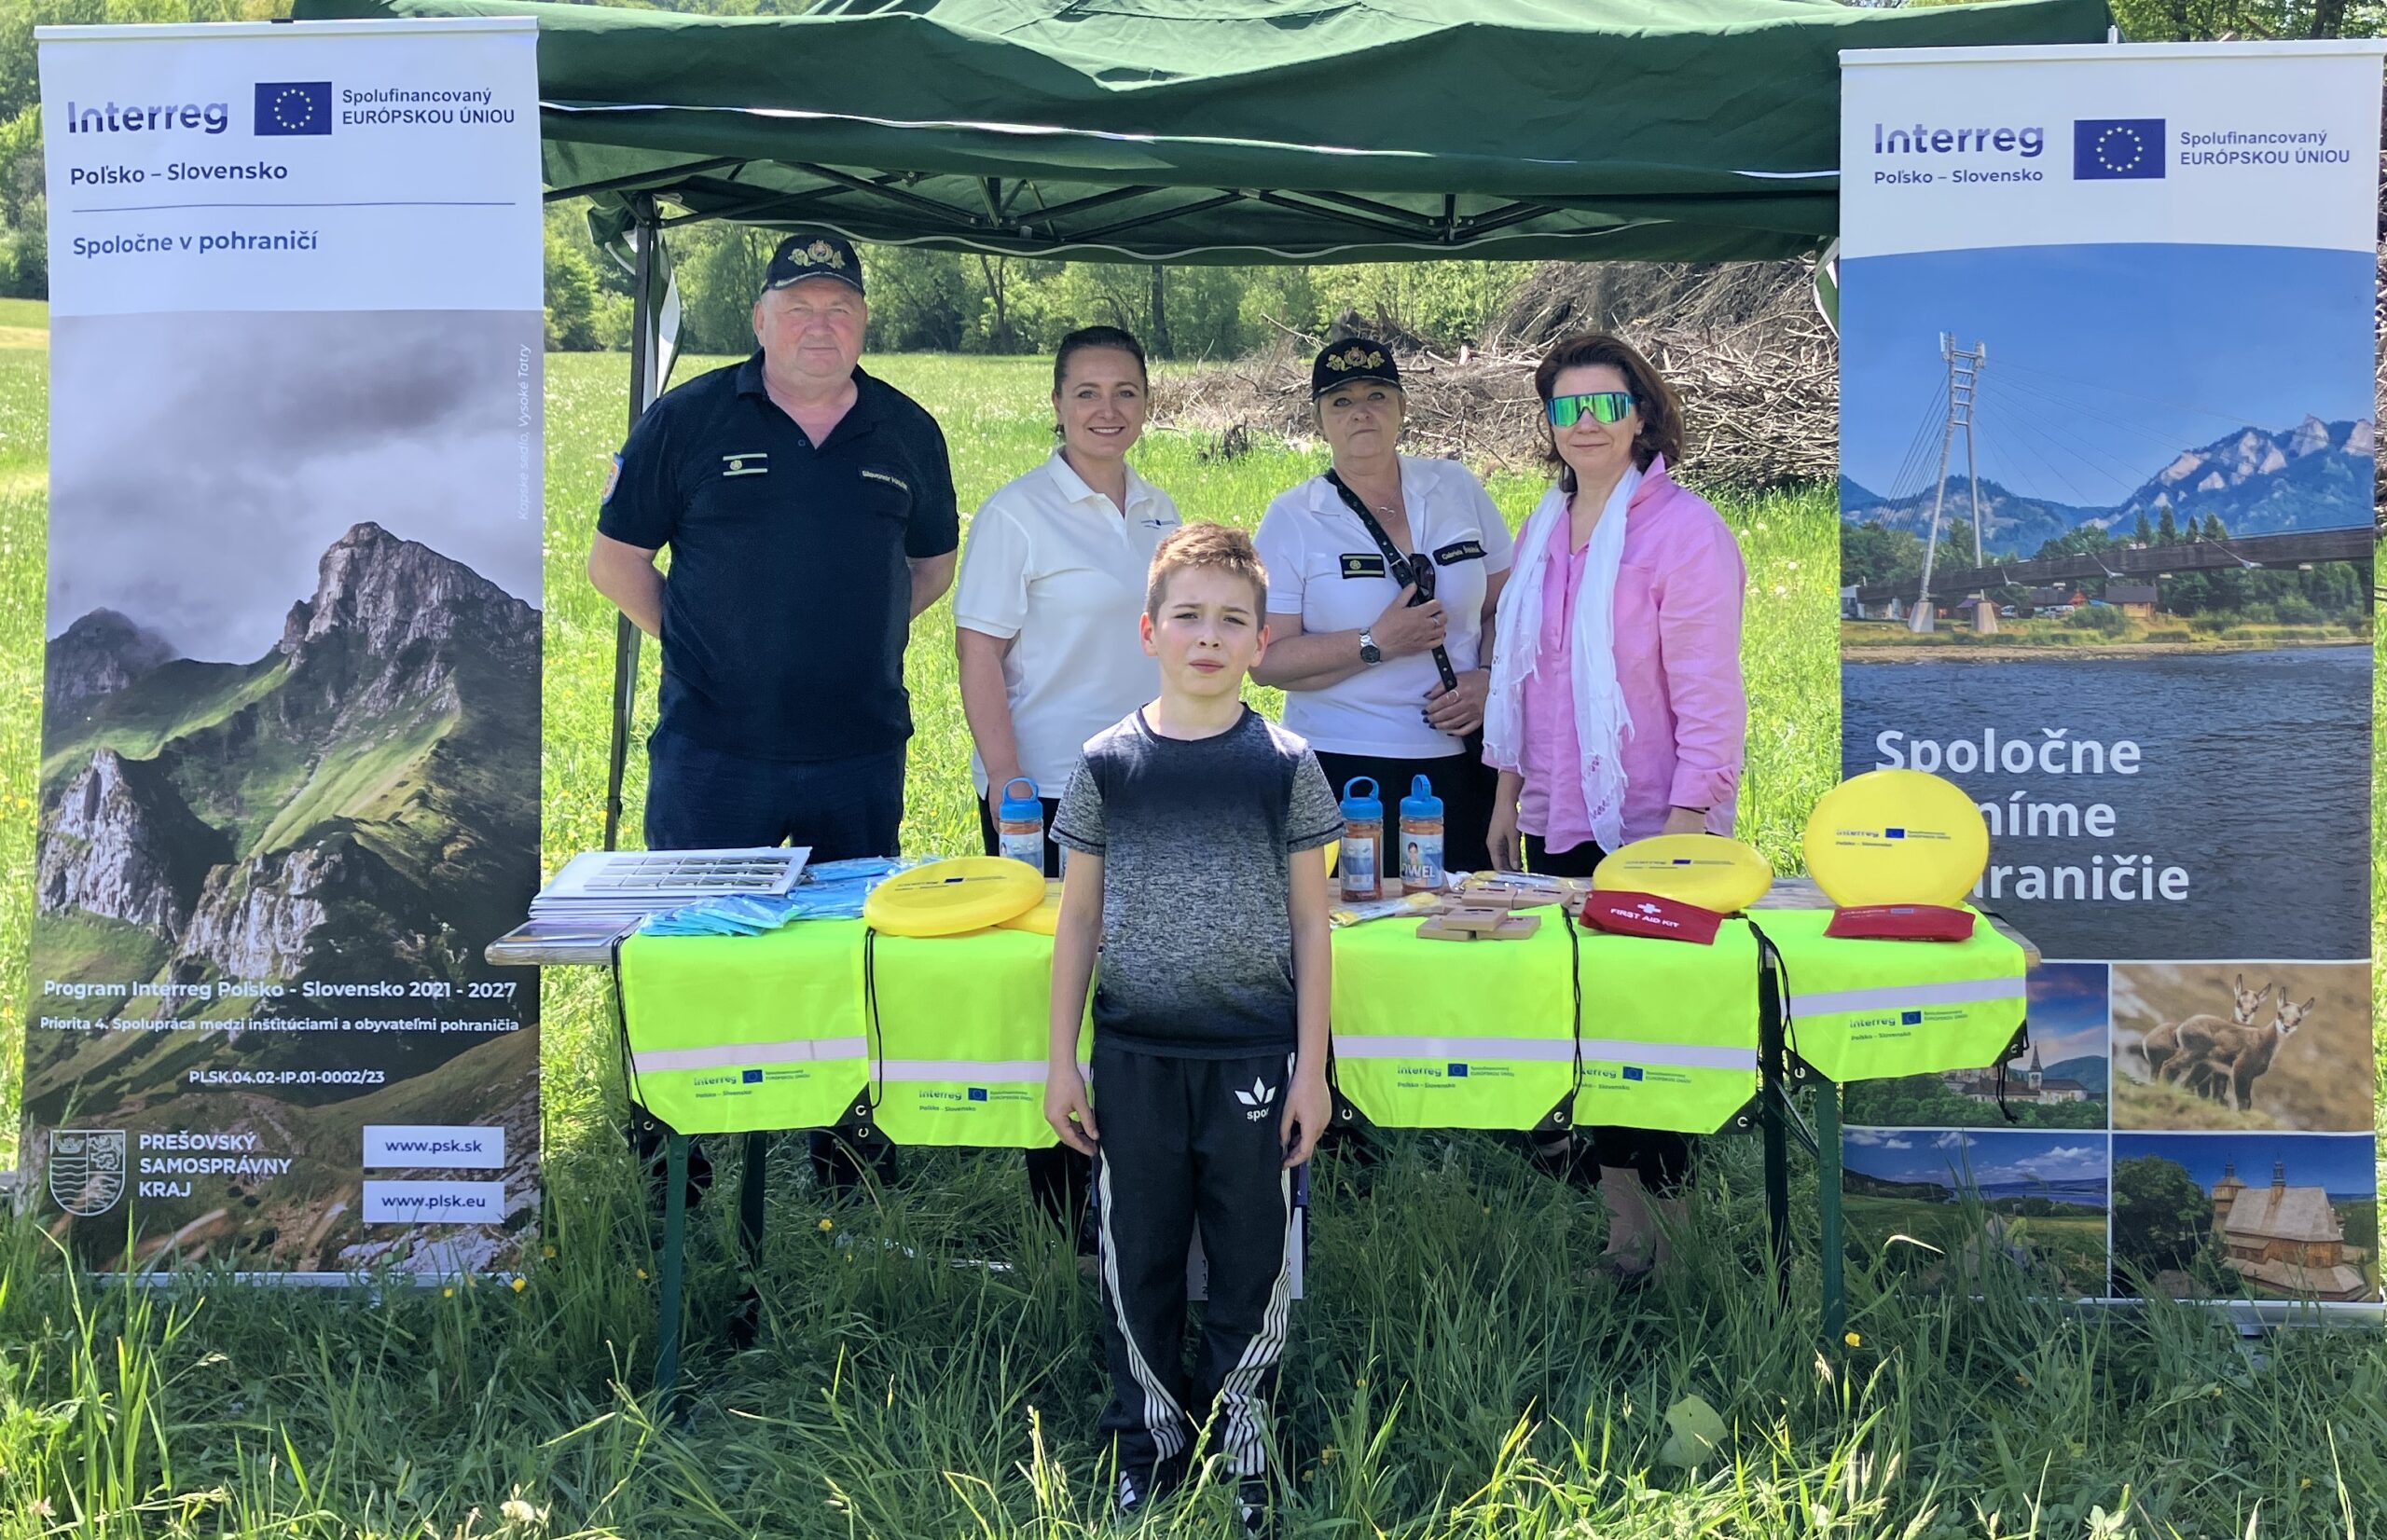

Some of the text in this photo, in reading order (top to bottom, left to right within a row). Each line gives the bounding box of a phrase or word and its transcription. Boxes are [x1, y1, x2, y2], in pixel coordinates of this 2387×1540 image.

[342, 88, 492, 107] Spolufinancovaný
[68, 101, 229, 135] Interreg
[342, 105, 516, 125] EURÓPSKOU ÚNIOU
[1874, 122, 2045, 158] Interreg
[2180, 129, 2327, 147] Spolufinancovaný
[2180, 145, 2351, 166] EURÓPSKOU ÚNIOU
[70, 165, 145, 185] Poľsko
[167, 161, 288, 182] Slovensko
[1874, 169, 1933, 185] Poľsko
[1952, 168, 2044, 184] Slovensko
[73, 229, 318, 259] Spoločne v pohraničí
[517, 344, 531, 378] Tatry
[518, 382, 531, 428] Vysoké
[1875, 728, 2141, 774] Spoločne
[1974, 791, 2116, 837] níme
[1974, 855, 2189, 901] raničie
[1610, 908, 1679, 928] FIRST AID KIT
[44, 981, 126, 999] Program
[132, 982, 212, 1000] Interreg
[218, 981, 284, 997] Poľsko
[302, 981, 405, 997] Slovensko
[409, 982, 450, 997] 2021
[468, 983, 517, 998] 2027
[40, 1016, 519, 1034] Priorita 4. Spolupráca medzi inštitúciami a obyvateľmi pohraničia
[189, 1069, 385, 1085] PLSK.04.02-IP.01-0002/23
[139, 1128, 257, 1150] PREŠOVSKÝ
[385, 1138, 483, 1156] www.psk.sk
[139, 1154, 292, 1176] SAMOSPRÁVNY
[139, 1181, 192, 1199] KRAJ
[381, 1193, 486, 1211] www.plsk.eu
